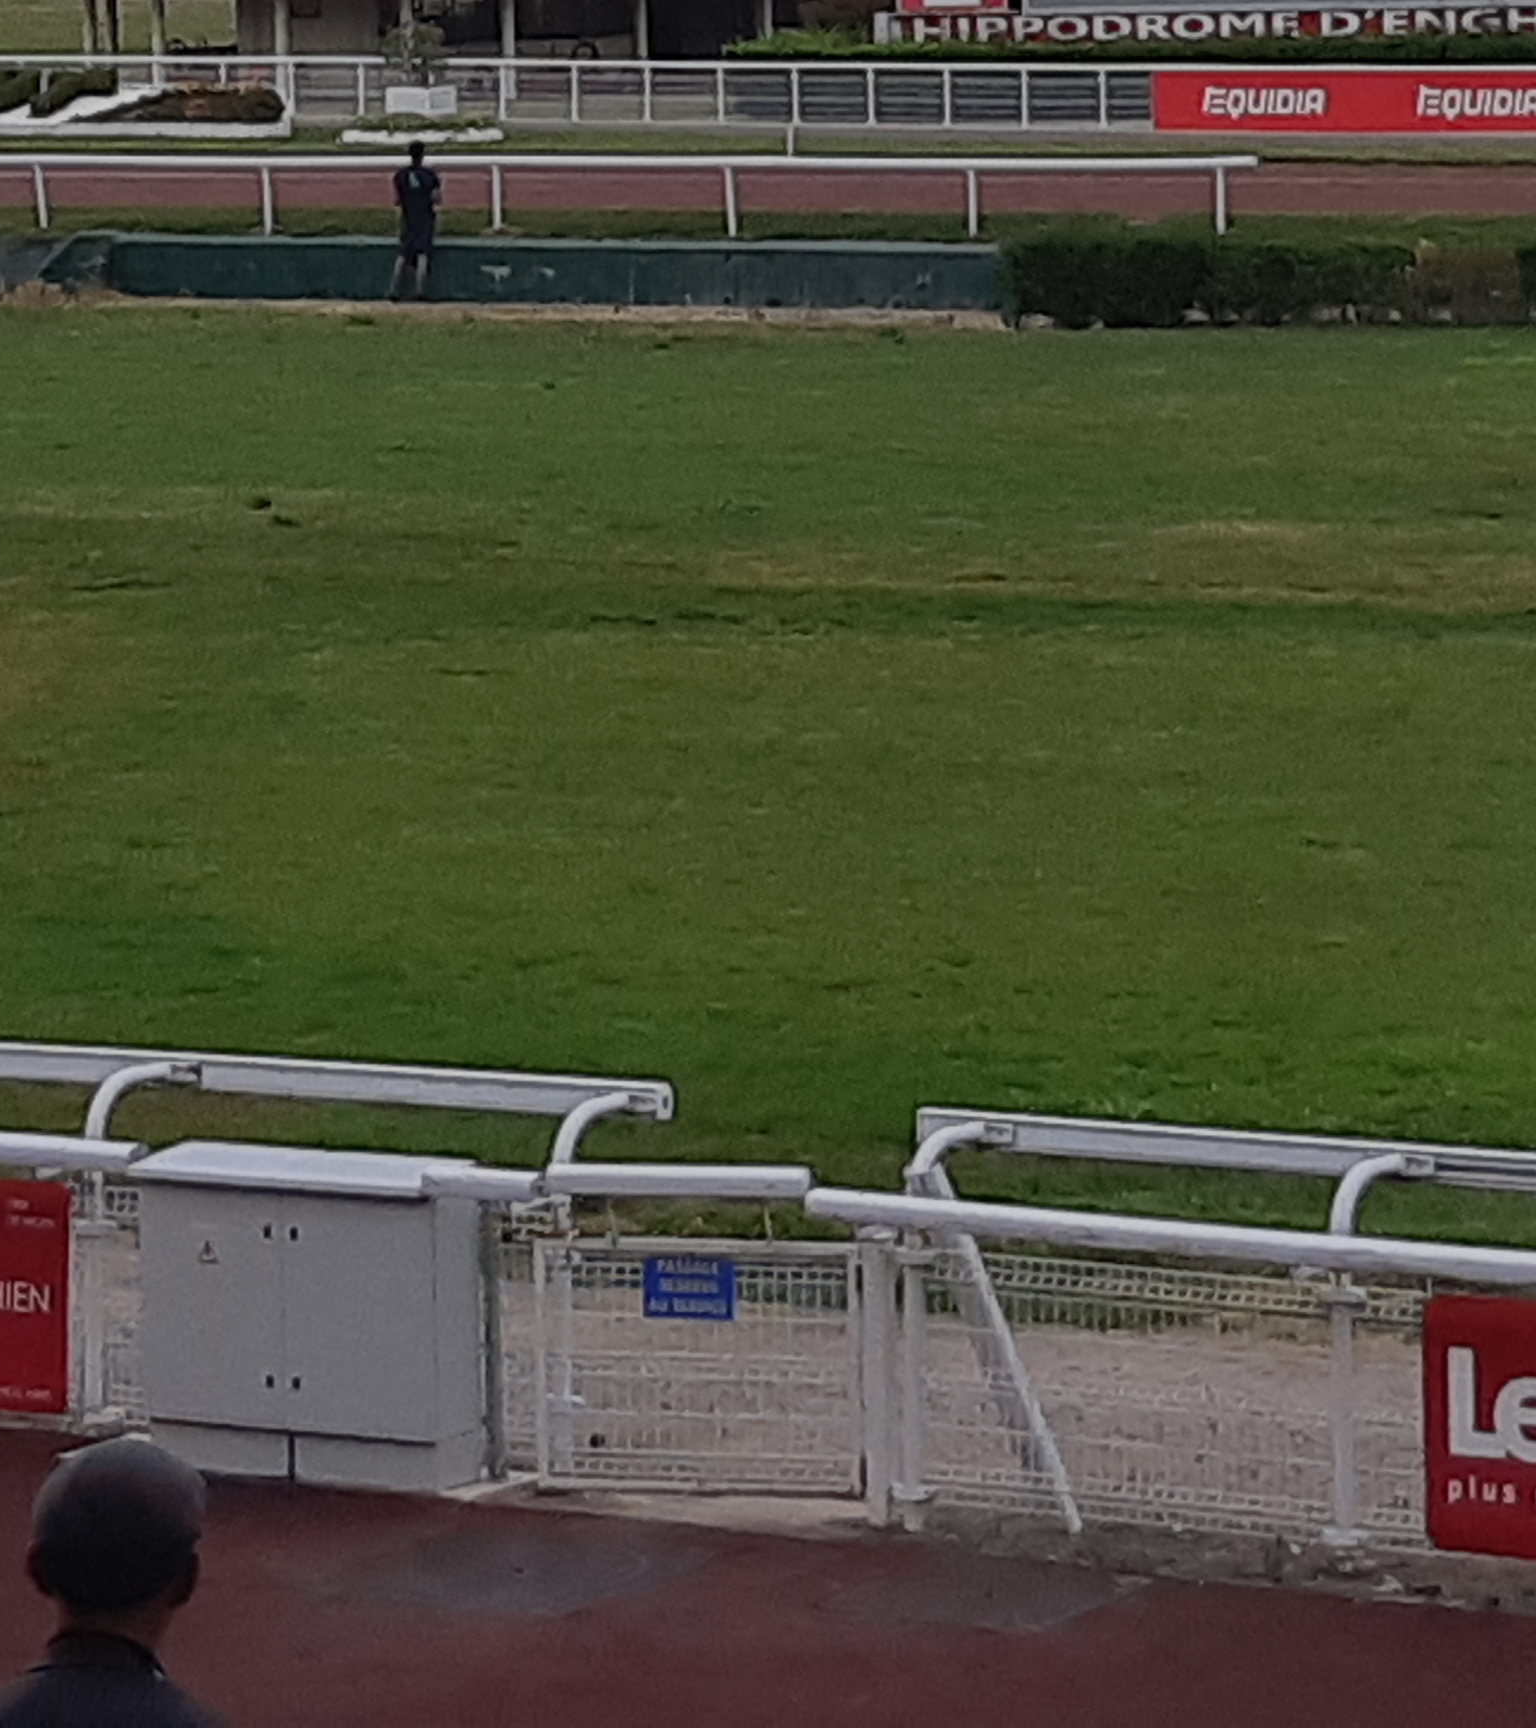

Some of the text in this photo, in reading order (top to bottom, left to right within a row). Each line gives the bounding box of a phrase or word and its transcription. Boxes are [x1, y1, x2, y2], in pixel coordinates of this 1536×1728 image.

[911, 12, 1301, 43] HIPPODROME
[1201, 85, 1326, 119] EQUIDIA
[1447, 1476, 1517, 1505] plus
